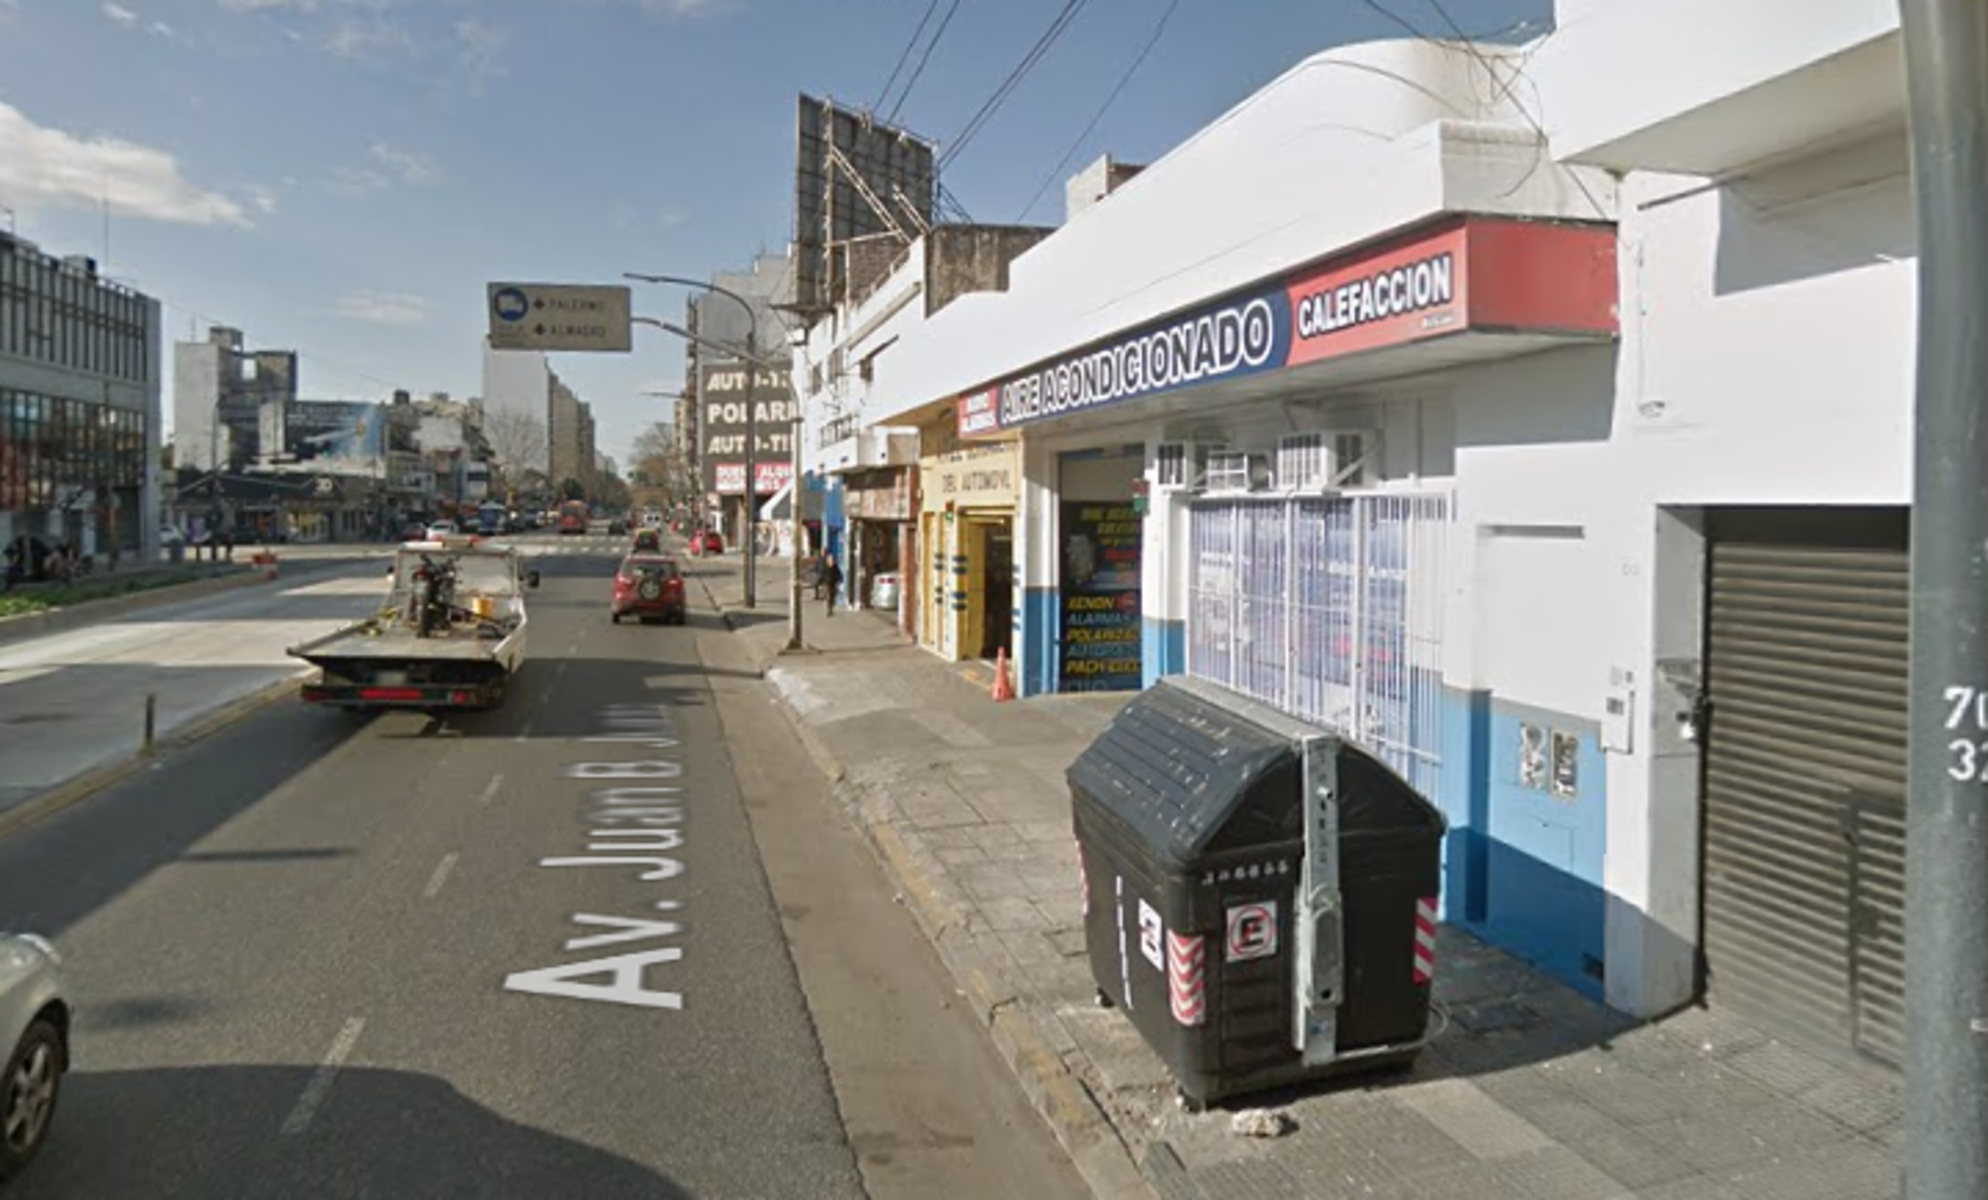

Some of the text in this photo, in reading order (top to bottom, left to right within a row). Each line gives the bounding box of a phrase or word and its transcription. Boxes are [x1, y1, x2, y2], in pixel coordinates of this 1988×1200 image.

[550, 324, 607, 338] ALMAGRO
[1298, 254, 1452, 338] CALEFACCION
[1001, 298, 1273, 423] AIRE ACONDICIONADO
